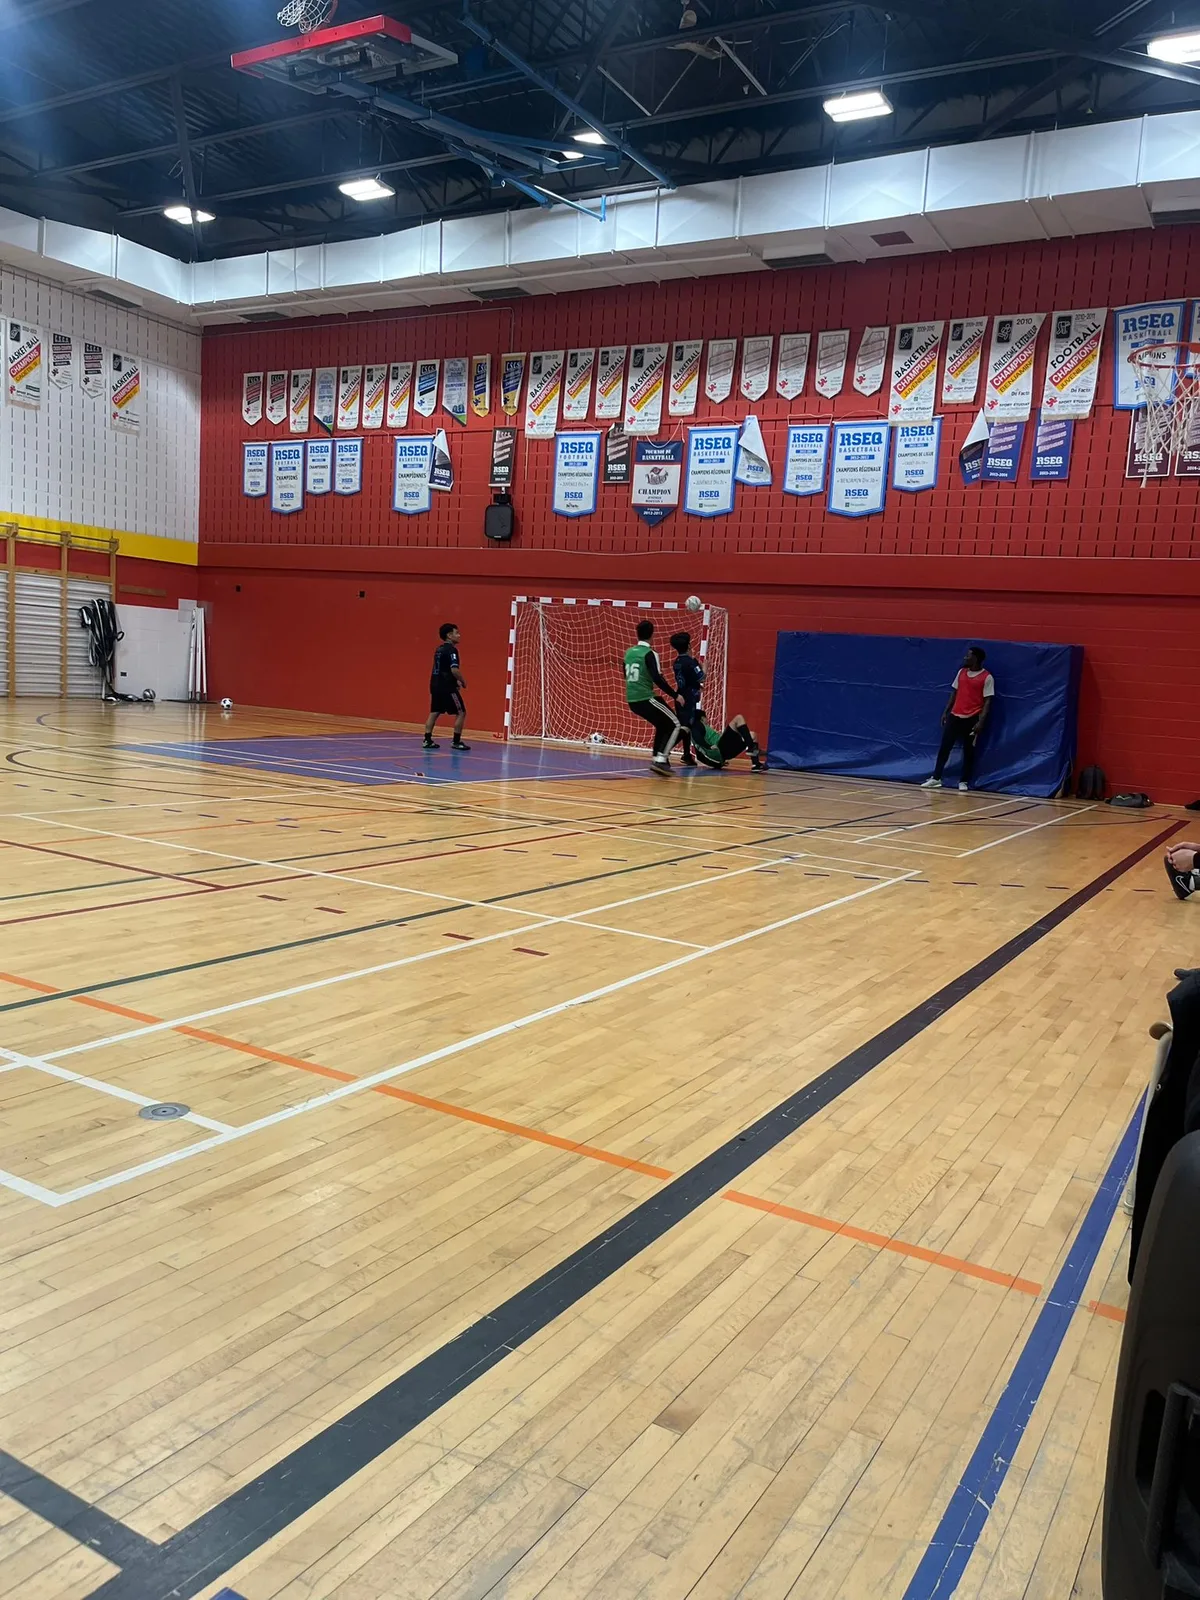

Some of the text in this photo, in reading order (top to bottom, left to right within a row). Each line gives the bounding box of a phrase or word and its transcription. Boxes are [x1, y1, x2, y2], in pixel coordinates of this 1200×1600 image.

[1122, 312, 1175, 334] RSEQ
[1122, 329, 1172, 341] BASKETBALL
[8, 335, 39, 364] BASKET-BALL
[894, 333, 939, 378] BASKETBALL
[948, 328, 983, 362] BASKETBALL
[950, 341, 981, 372] CHAMPIONS
[1051, 322, 1101, 369] FOOTBALL
[10, 348, 39, 377] CHAMPIONS
[112, 355, 138, 391] BASKETBALL
[567, 357, 592, 386] BASKETBALL
[599, 356, 624, 384] FOOTBALL
[630, 353, 665, 392] BASKETBALL
[673, 350, 700, 380] BASKETBALL
[896, 350, 937, 391] CHAMPIONS
[993, 343, 1034, 386] CHAMPIONS
[1052, 339, 1098, 383] CHAMPIONS
[391, 371, 410, 397] FOOTBALL
[530, 361, 561, 398] BASKETBALL
[531, 374, 560, 410] CHAMPIONNES
[631, 368, 663, 405] CHAMPIONNES
[694, 437, 732, 450] RSEQ
[792, 433, 823, 443] RSEQ
[840, 432, 883, 446] RSEQ
[900, 425, 935, 437] RSEQ
[247, 449, 265, 457] RSEQ
[275, 449, 300, 460] RSEQ
[399, 446, 428, 456] RSEQ
[560, 442, 594, 453] RSEQ
[1036, 456, 1063, 465] RSEQ
[434, 468, 450, 476] RSEQ
[965, 459, 981, 470] RSE
[987, 457, 1012, 467] RSEQ
[698, 490, 719, 498] RSEQ
